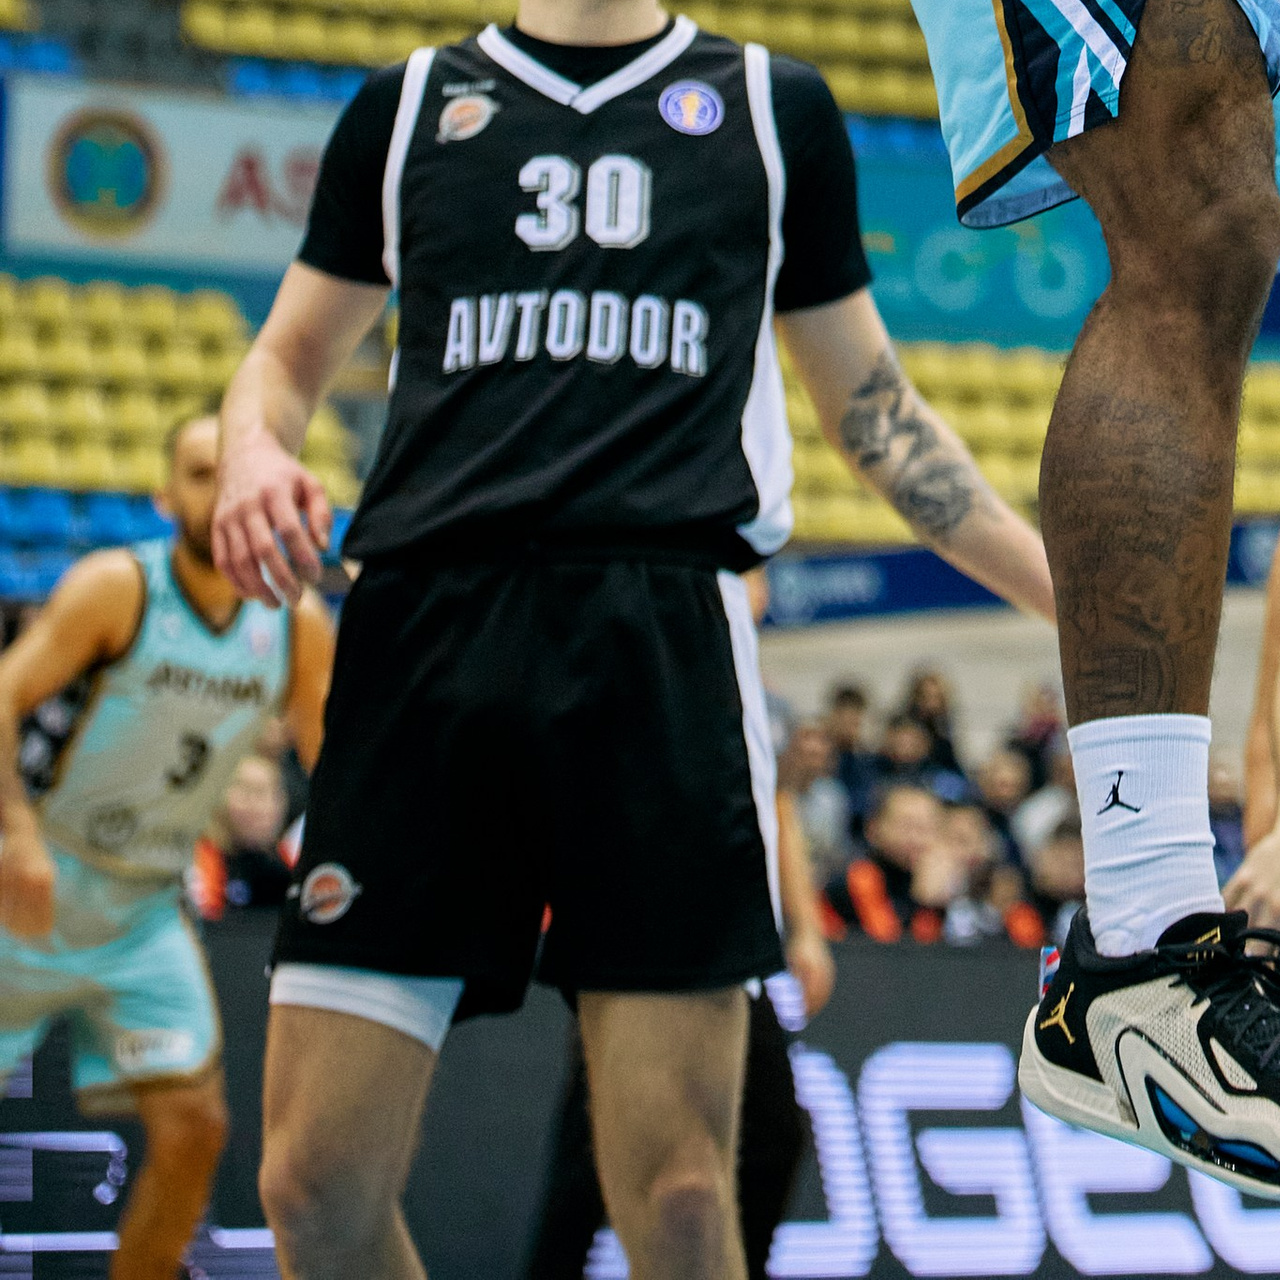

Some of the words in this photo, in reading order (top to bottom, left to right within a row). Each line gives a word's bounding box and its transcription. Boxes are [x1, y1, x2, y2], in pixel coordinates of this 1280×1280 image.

[515, 154, 652, 251] 30
[443, 290, 710, 378] AVTODOR
[164, 732, 210, 788] 3
